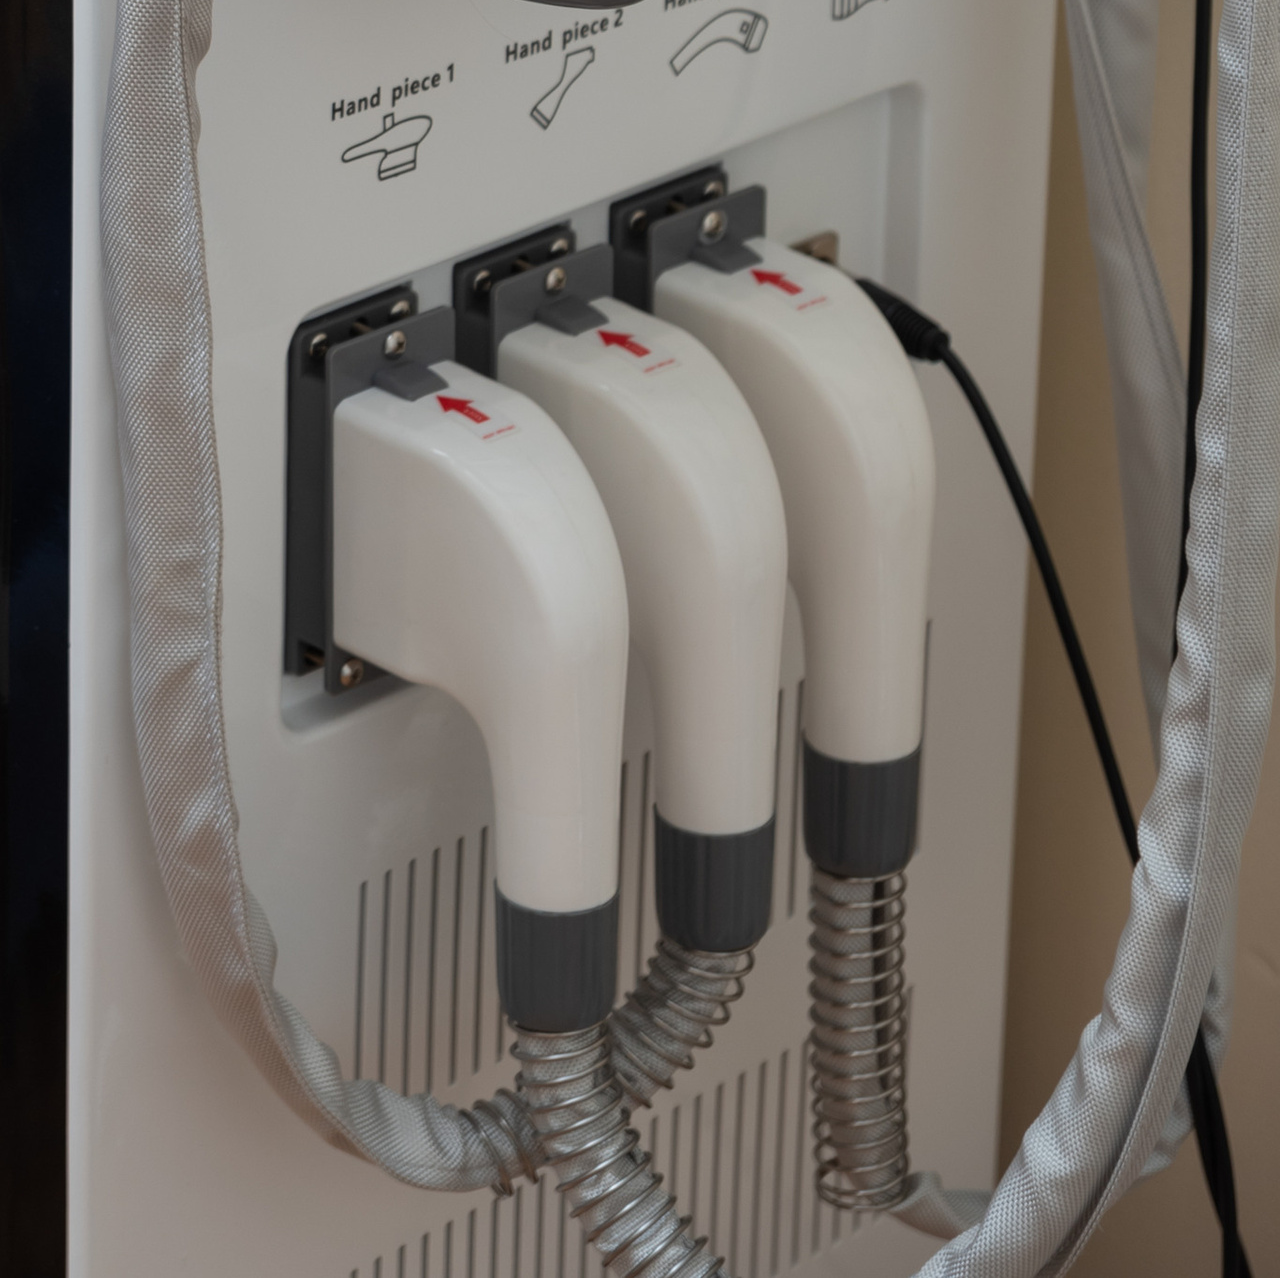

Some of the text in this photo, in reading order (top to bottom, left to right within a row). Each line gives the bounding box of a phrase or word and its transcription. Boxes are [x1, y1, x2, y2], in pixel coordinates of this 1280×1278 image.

[505, 9, 624, 64] Hand piece 2
[331, 62, 455, 121] Hand piece 1
